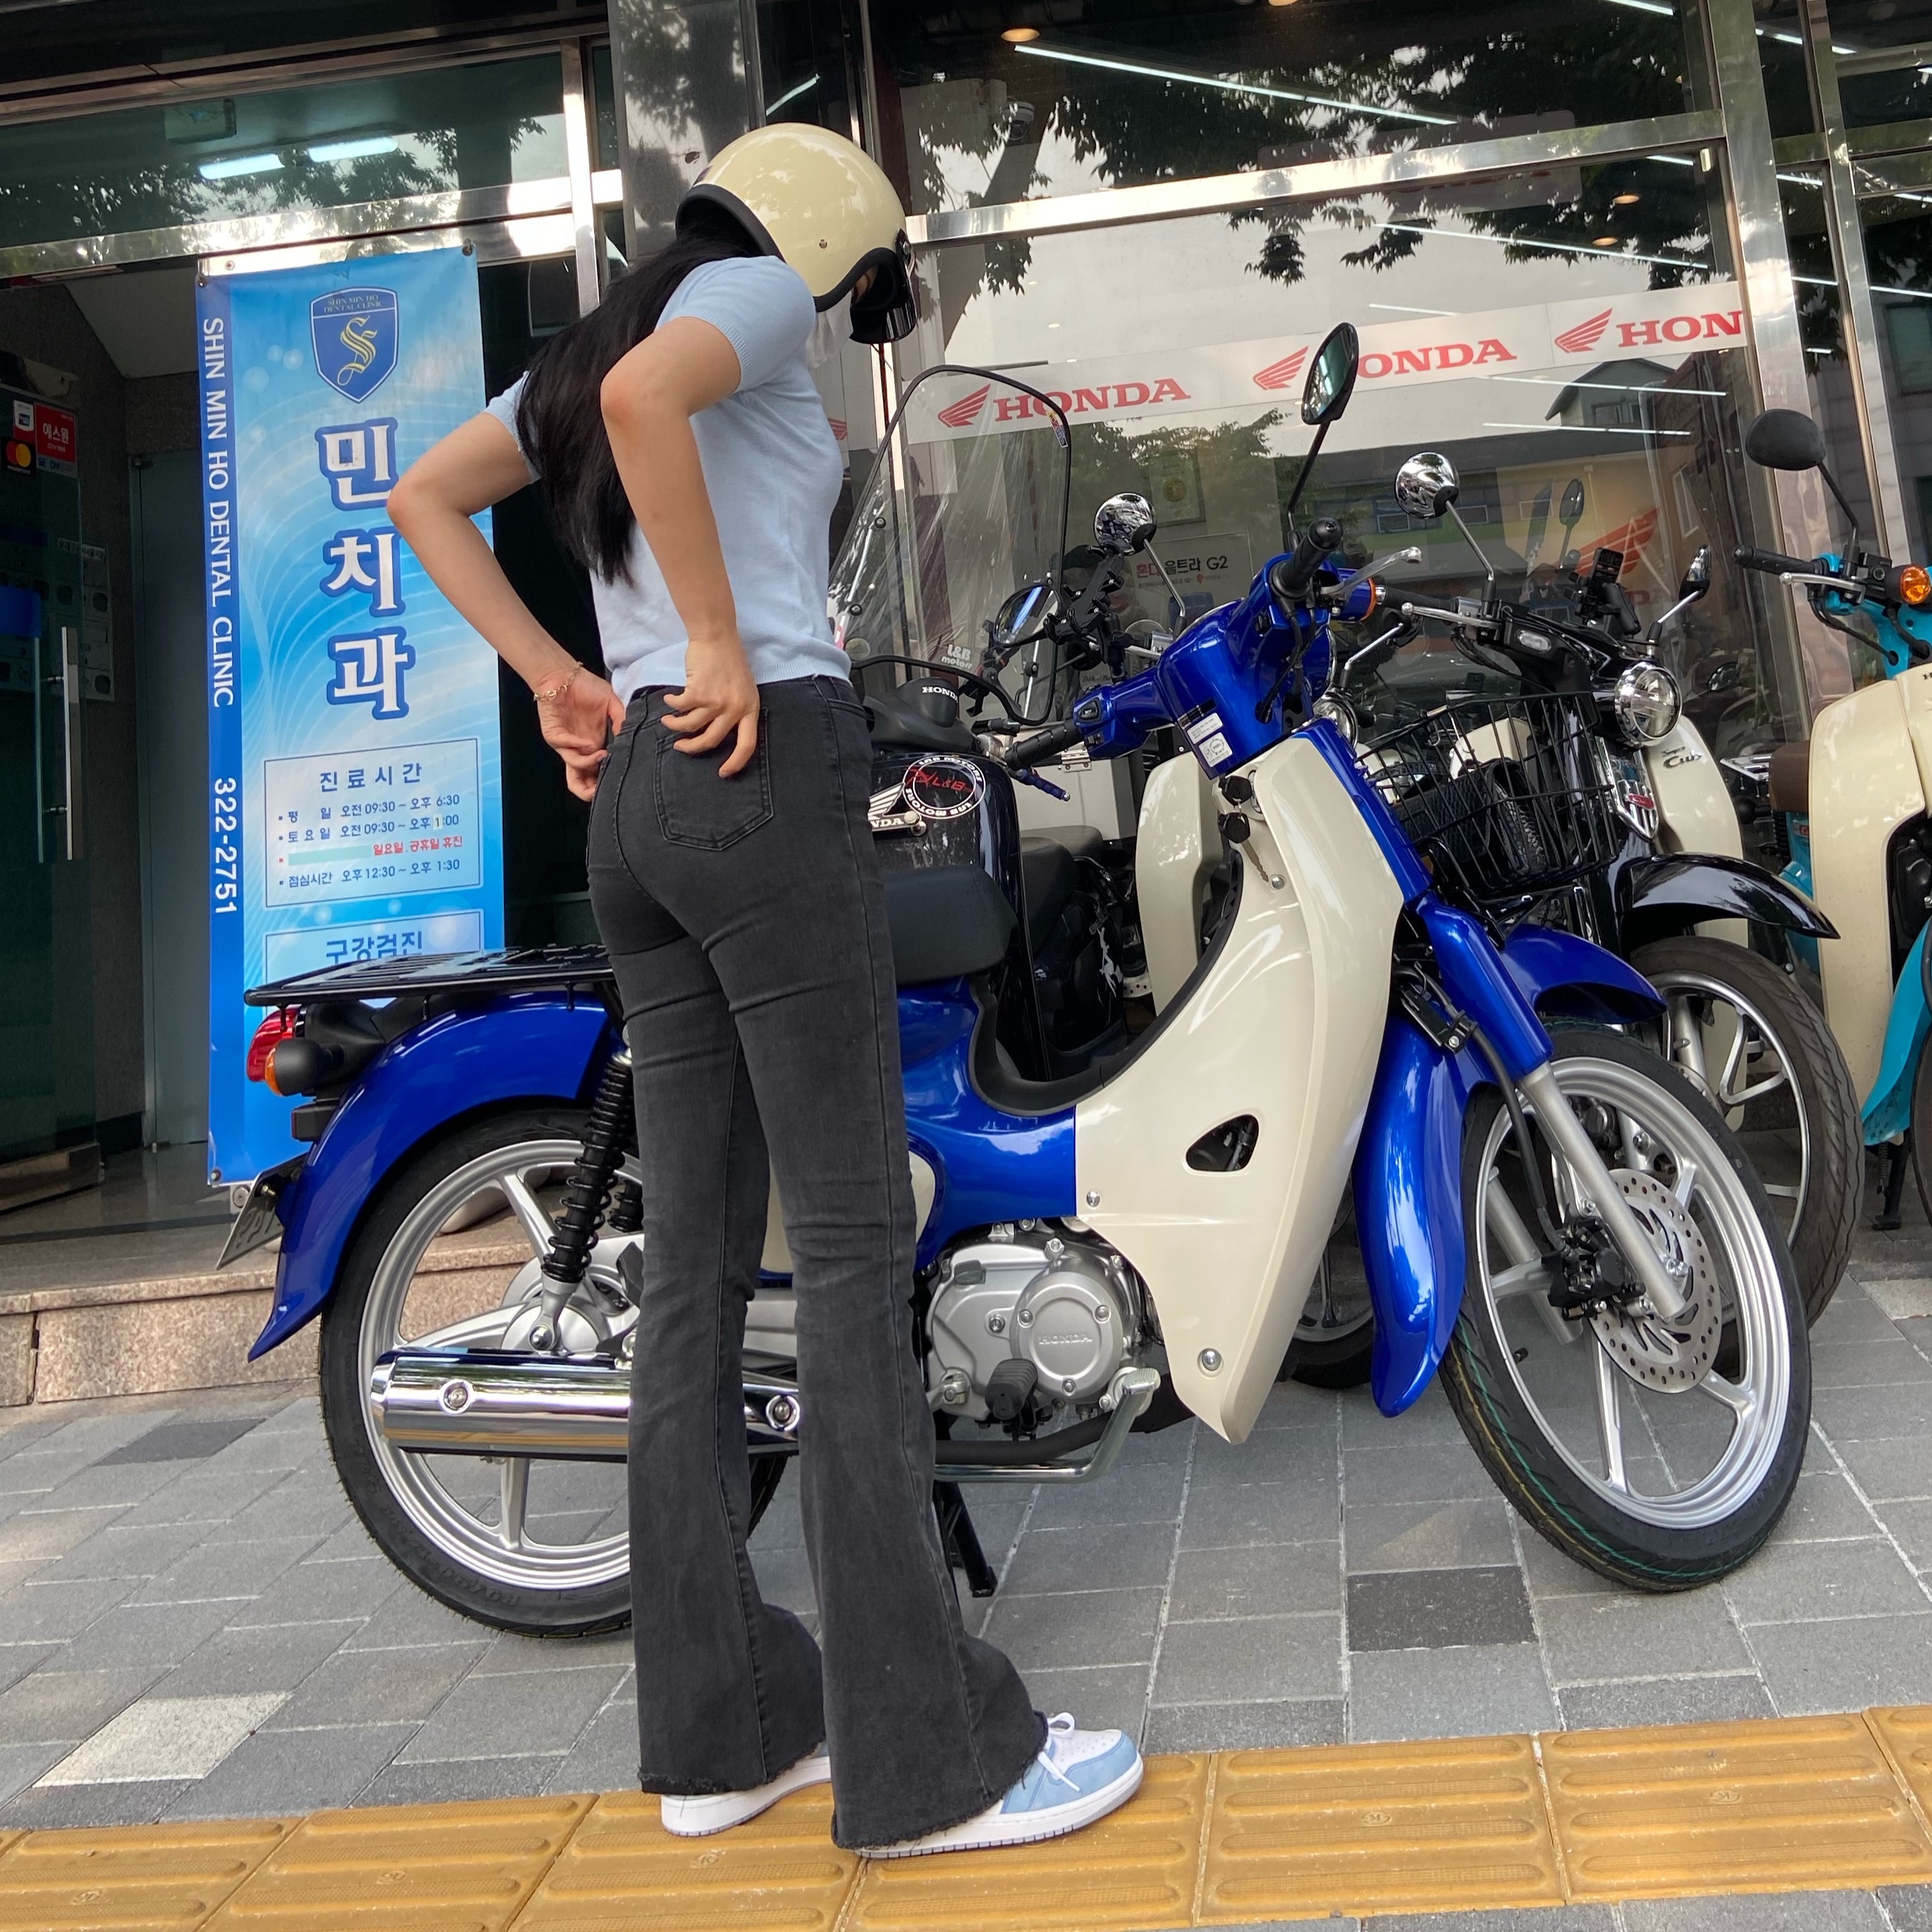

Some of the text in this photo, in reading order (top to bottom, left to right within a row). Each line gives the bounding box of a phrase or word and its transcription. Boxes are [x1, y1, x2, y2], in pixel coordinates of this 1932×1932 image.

[324, 304, 355, 313] DENTAL
[328, 297, 347, 306] SHIN
[1357, 338, 1517, 379] ONDA
[993, 378, 1192, 422] HONDA
[42, 423, 69, 444] 에스원
[204, 317, 235, 708] SHIN MIN HO DENTAL CLINIC
[1165, 557, 1201, 575] 울트라
[1206, 555, 1228, 571] G2
[947, 643, 971, 661] L&B
[1663, 749, 1702, 769] Cub
[410, 797, 431, 810] 오후
[436, 794, 460, 807] 6:30
[905, 787, 947, 816] MOTORS
[410, 817, 430, 830] 오후
[435, 814, 459, 828] 1:00
[869, 817, 904, 828] NDA
[214, 777, 237, 914] 322-2751
[410, 838, 440, 853] 공휴일
[442, 835, 463, 848] 휴진
[288, 871, 333, 888] 점심시간
[410, 862, 432, 875] 오후
[437, 859, 460, 872] 1:30
[1038, 1334, 1093, 1345] HONDA
